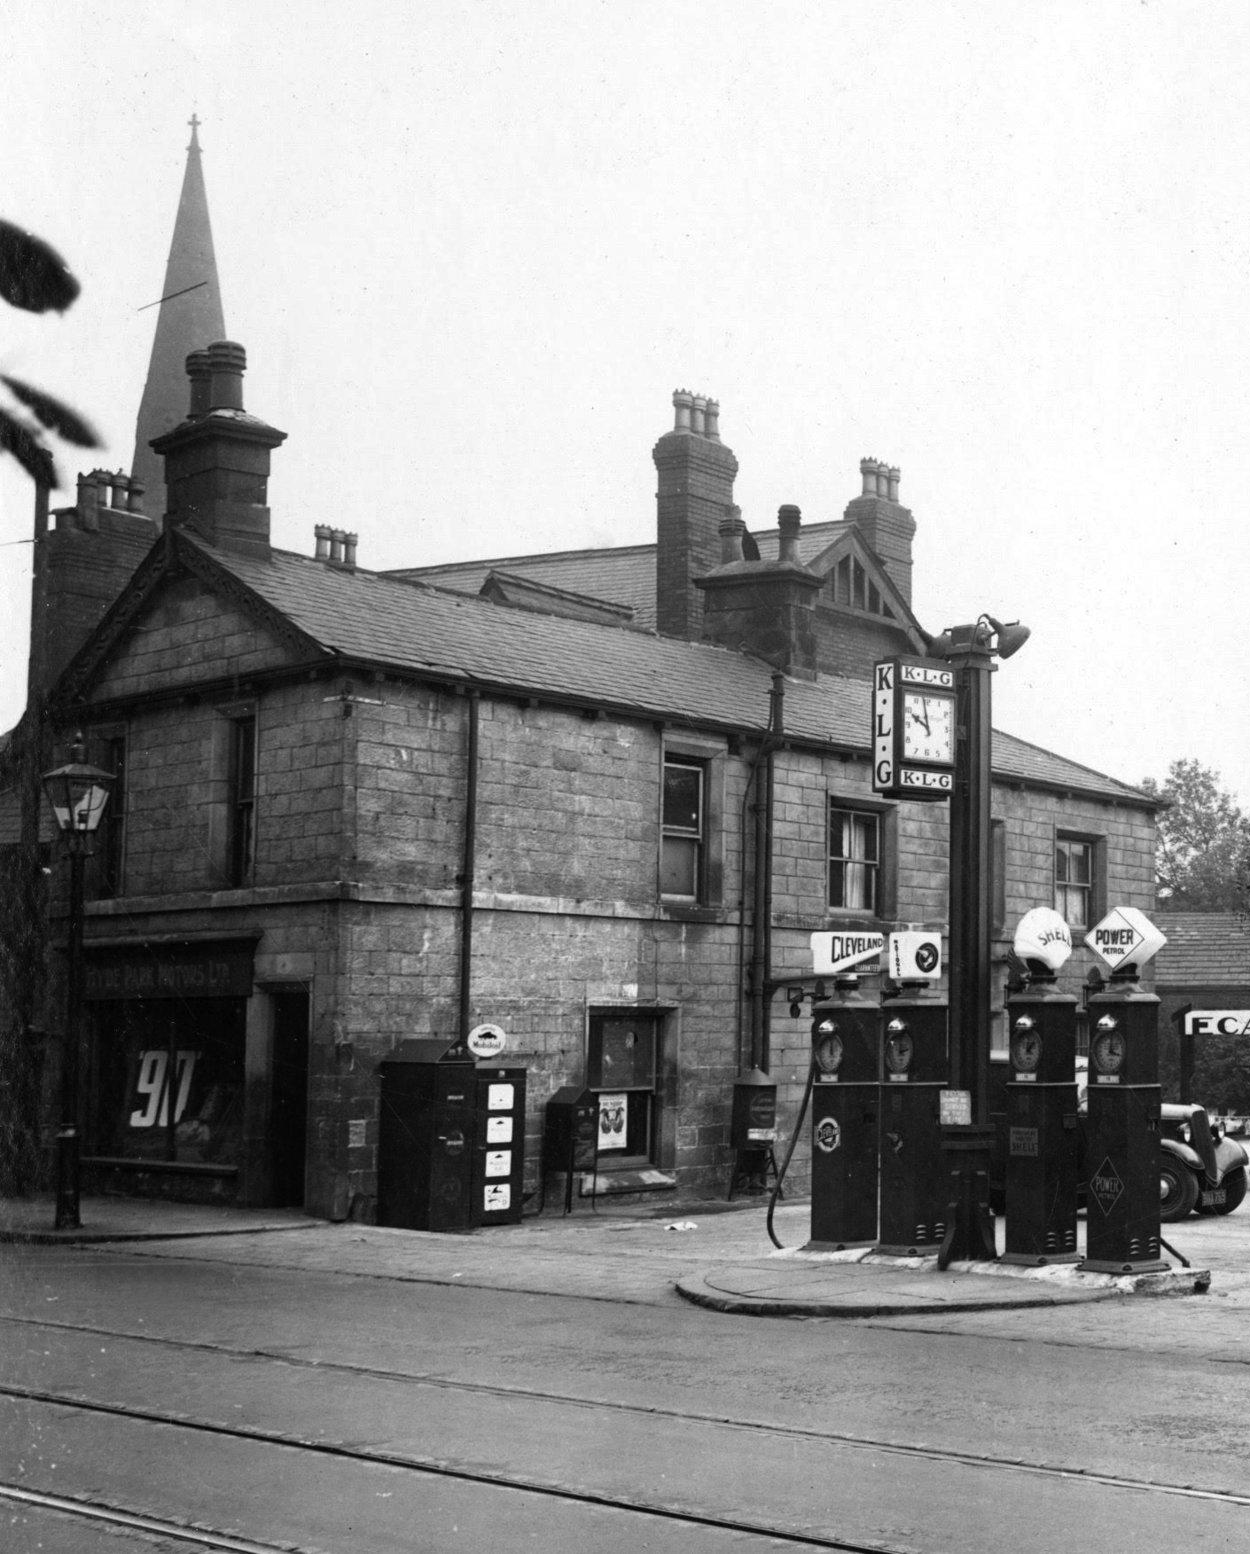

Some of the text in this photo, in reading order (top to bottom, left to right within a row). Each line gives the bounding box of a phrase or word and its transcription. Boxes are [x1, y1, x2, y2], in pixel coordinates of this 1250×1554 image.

[1095, 928, 1134, 946] POWER
[832, 935, 883, 964] CLEVELAND
[1102, 947, 1126, 956] PETROL
[1095, 1175, 1120, 1193] POWER
